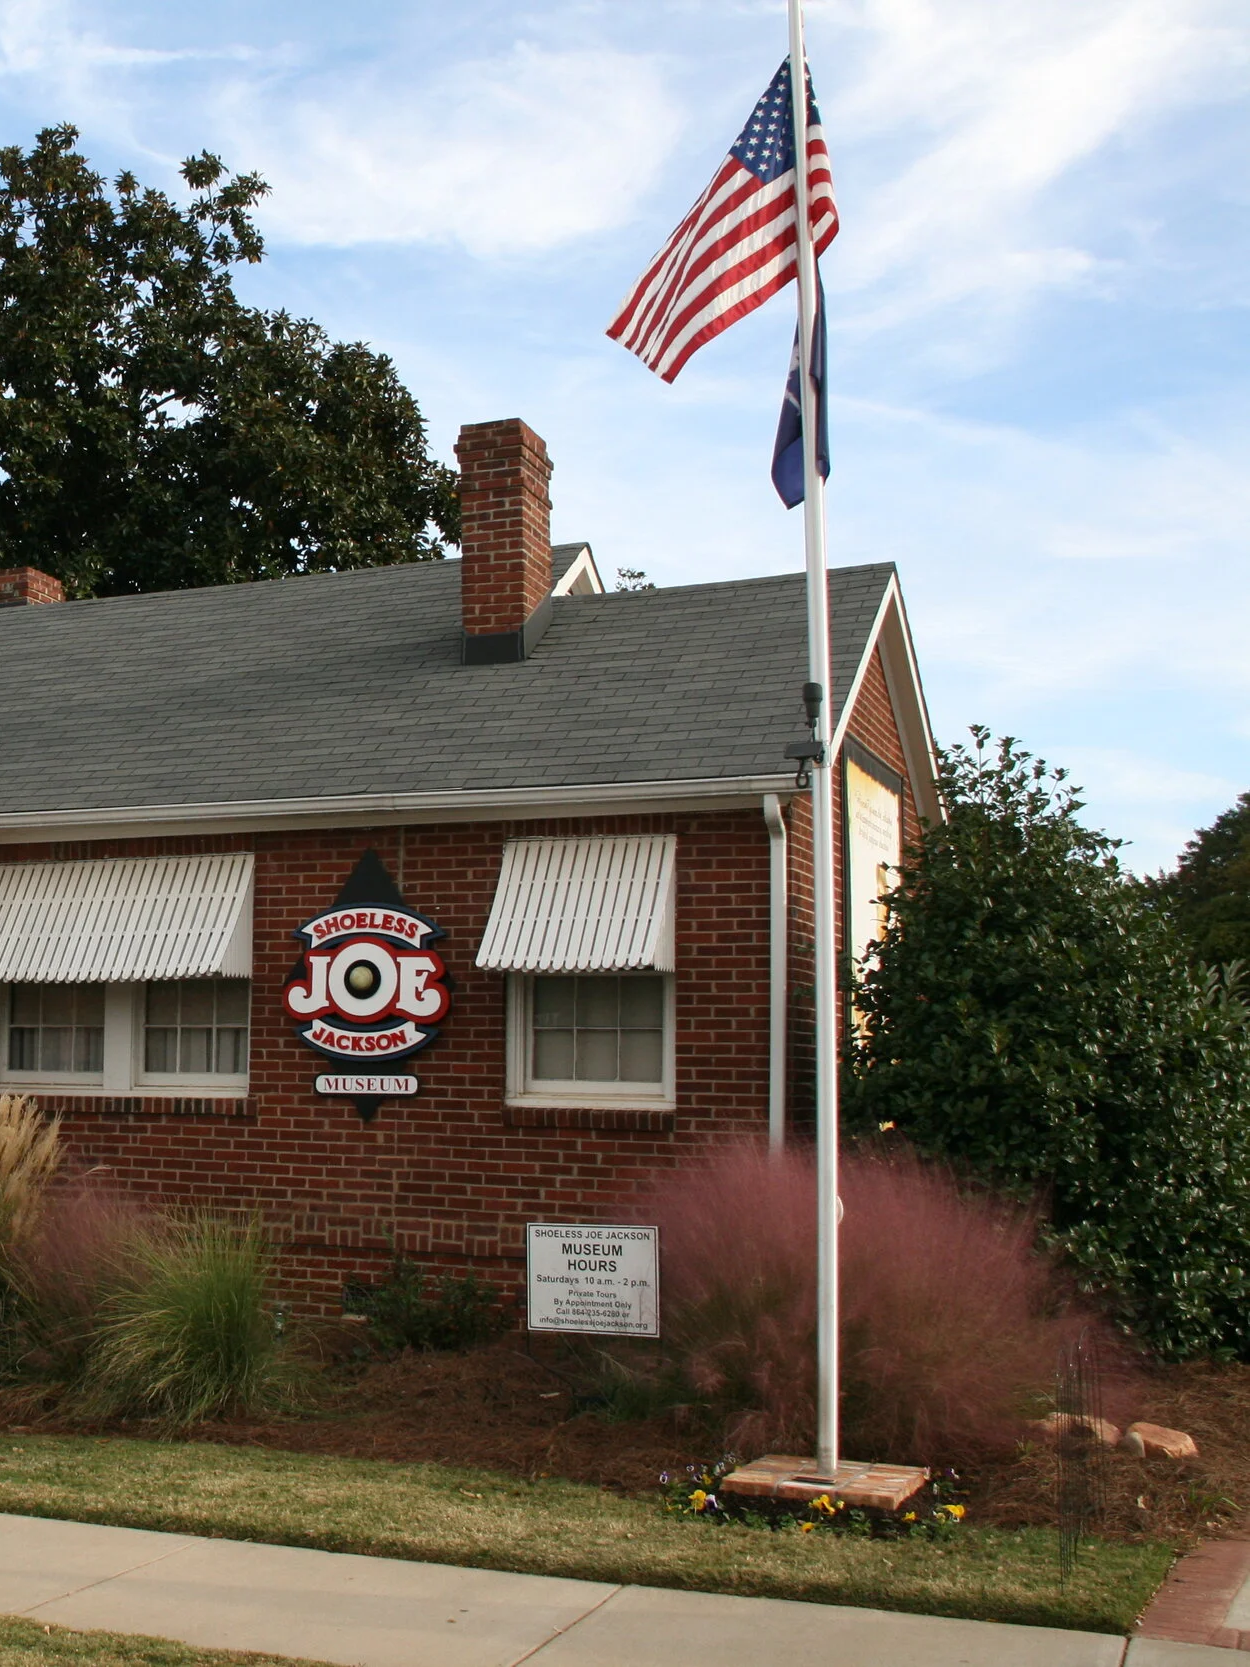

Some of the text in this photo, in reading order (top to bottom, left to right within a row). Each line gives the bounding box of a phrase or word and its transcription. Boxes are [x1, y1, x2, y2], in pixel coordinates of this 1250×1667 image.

[312, 912, 419, 939] SHOELESS
[287, 941, 442, 1017] JOE
[311, 1026, 408, 1052] JACKSON
[323, 1076, 411, 1092] MUSEUM
[535, 1229, 650, 1241] SHOELESS JOE JACKSON
[561, 1243, 623, 1257] MUSEUM
[567, 1259, 617, 1273] HOURS
[536, 1274, 579, 1286] Saturdays
[584, 1276, 595, 1285] 10
[596, 1278, 615, 1286] a.m.
[623, 1278, 629, 1286] 2
[630, 1279, 650, 1288] p.m.
[568, 1289, 617, 1299] Private Tours
[553, 1298, 632, 1310] By Appointment Only
[555, 1307, 570, 1316] Call
